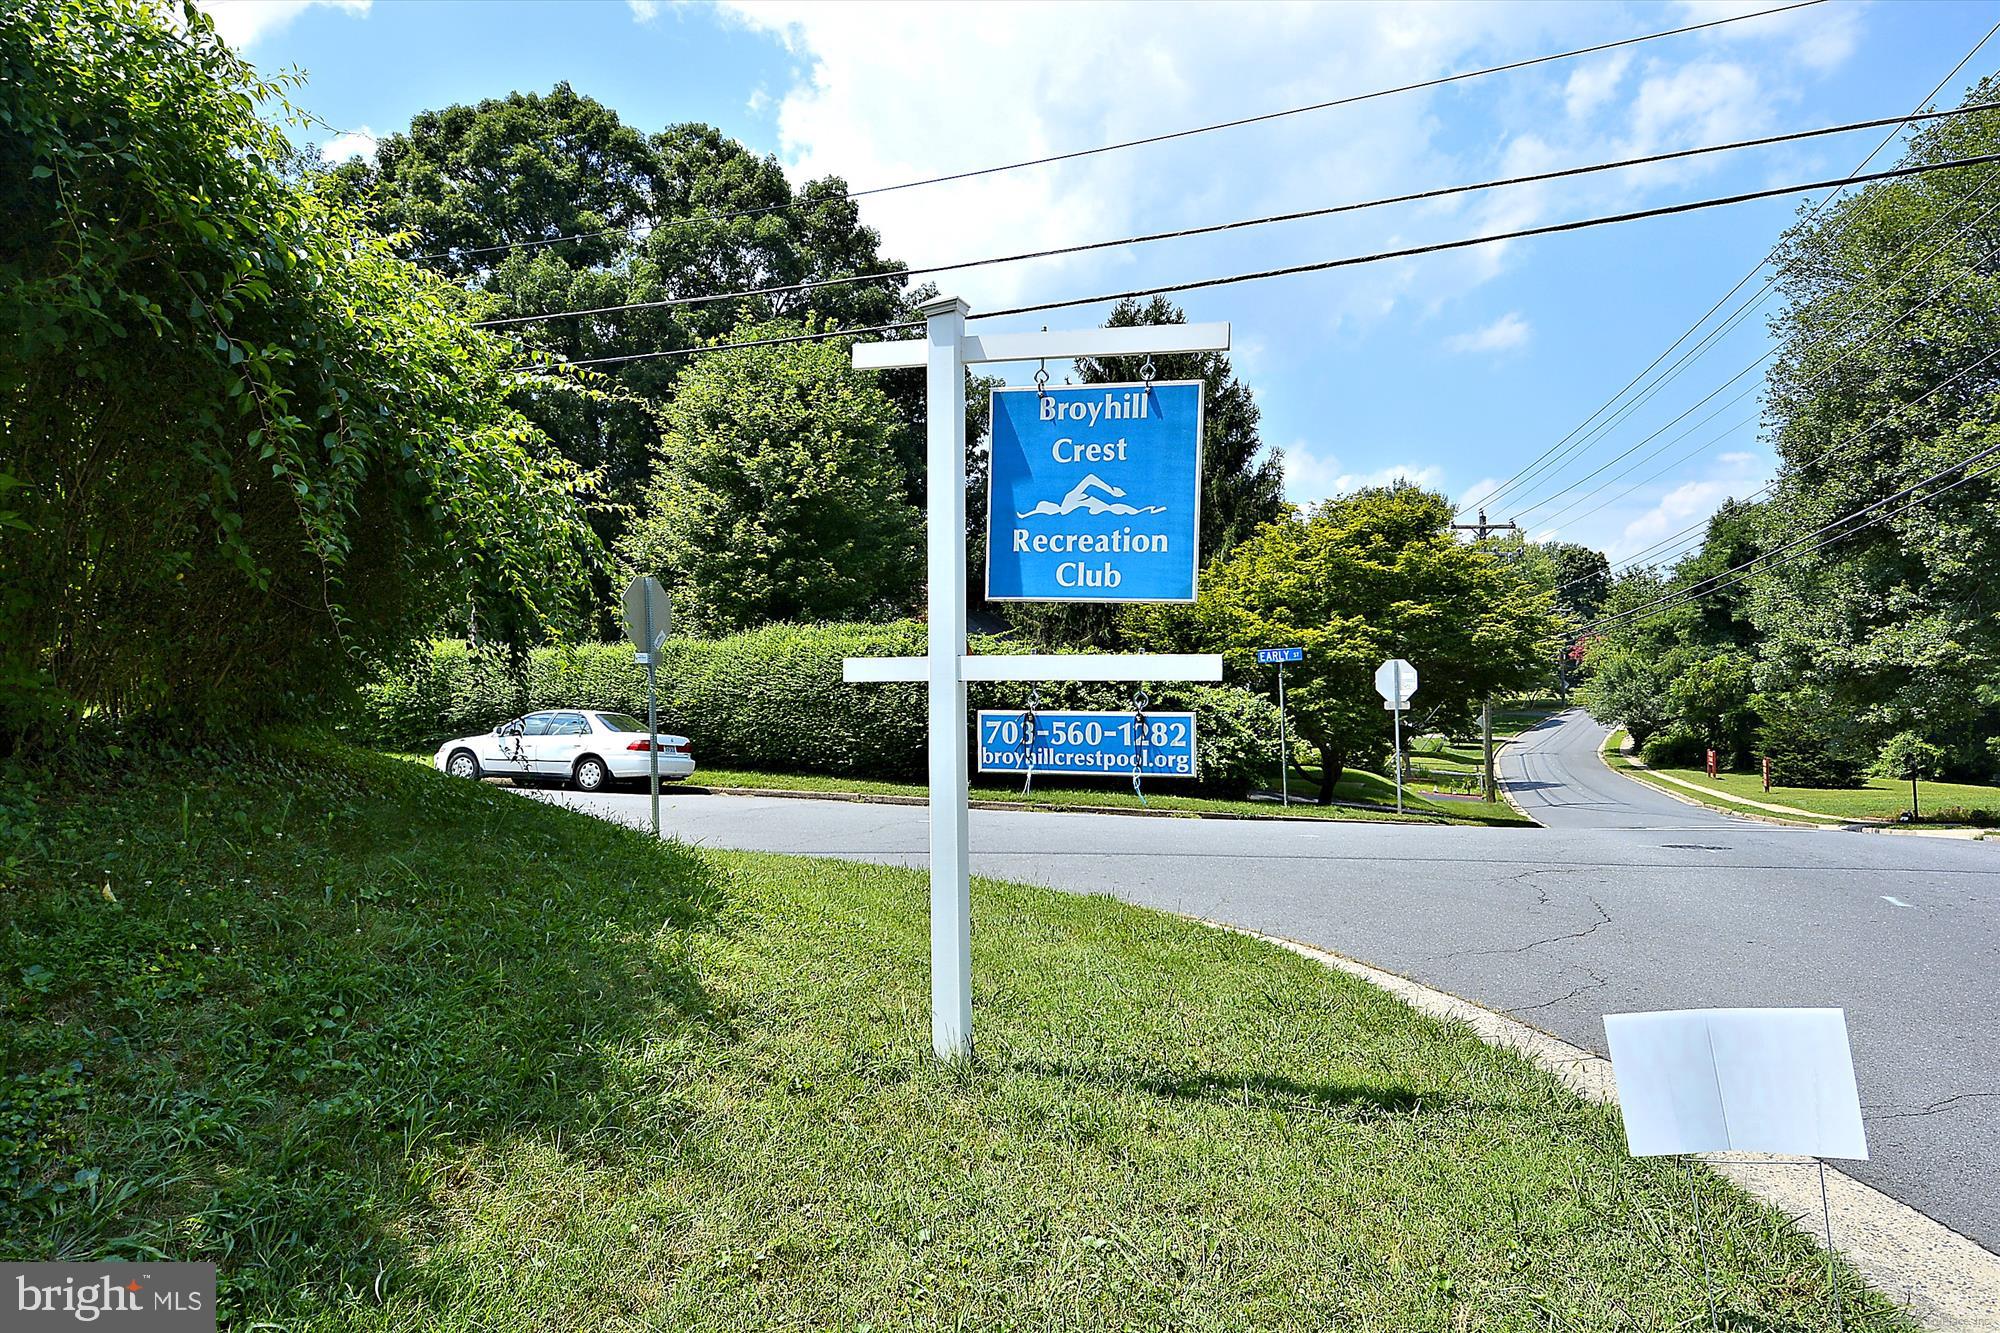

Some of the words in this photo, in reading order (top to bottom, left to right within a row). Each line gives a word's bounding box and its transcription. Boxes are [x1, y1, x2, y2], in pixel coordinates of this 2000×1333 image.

[1039, 393, 1149, 427] Broyhill
[1052, 437, 1127, 463] Crest
[1012, 527, 1169, 553] Recreation
[1055, 562, 1122, 588] Club
[1260, 650, 1290, 661] EARLY
